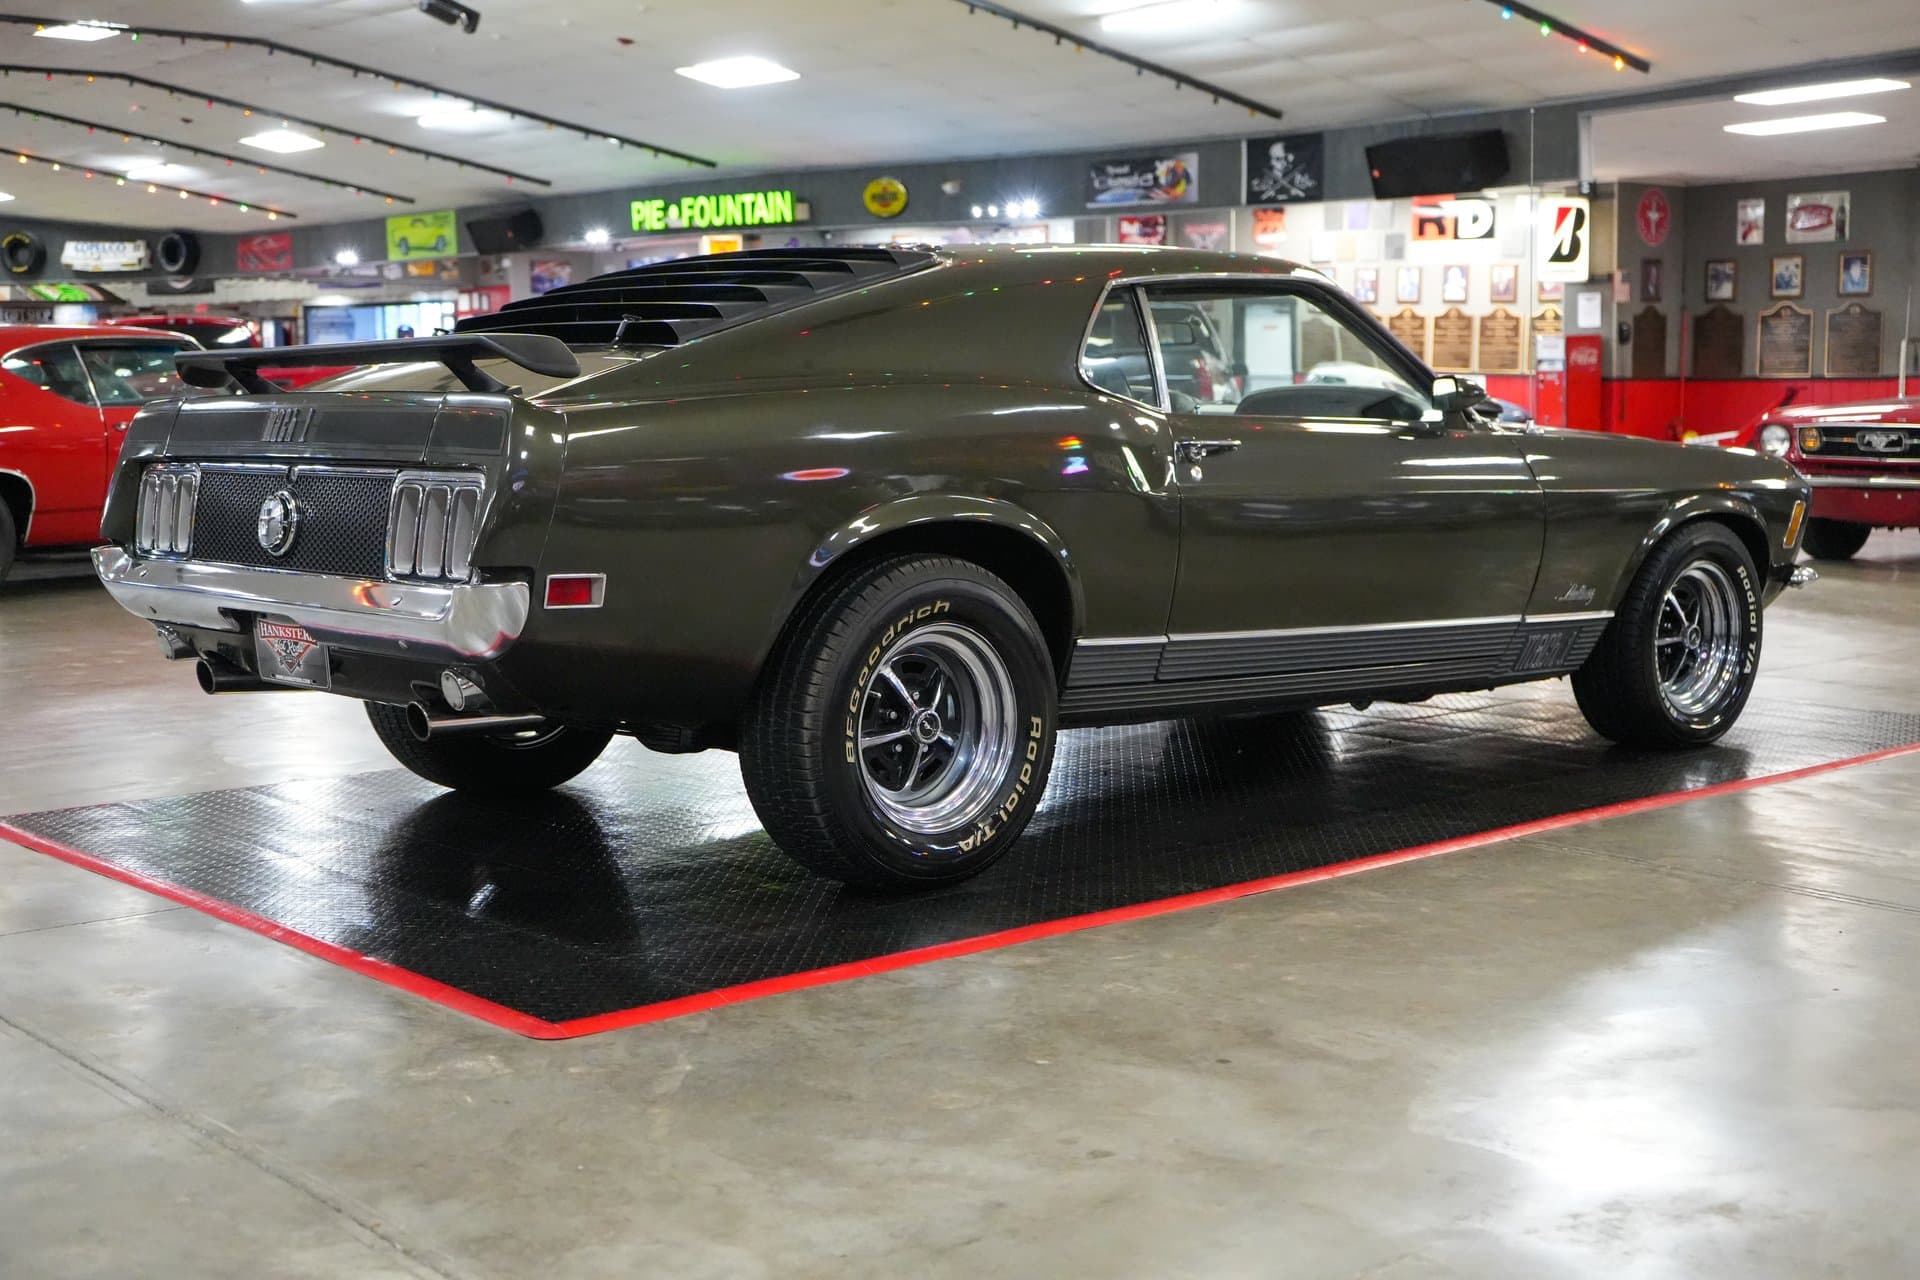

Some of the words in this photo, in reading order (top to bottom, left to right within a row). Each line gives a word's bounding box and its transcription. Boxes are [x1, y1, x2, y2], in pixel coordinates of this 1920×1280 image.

[631, 199, 666, 231] PIE
[681, 191, 793, 228] FOUNTAIN
[1737, 565, 1757, 632] Radial
[845, 600, 950, 764] BFGoodrich
[1744, 642, 1757, 674] T/A
[999, 715, 1042, 823] Radial
[959, 826, 998, 853] T/A
